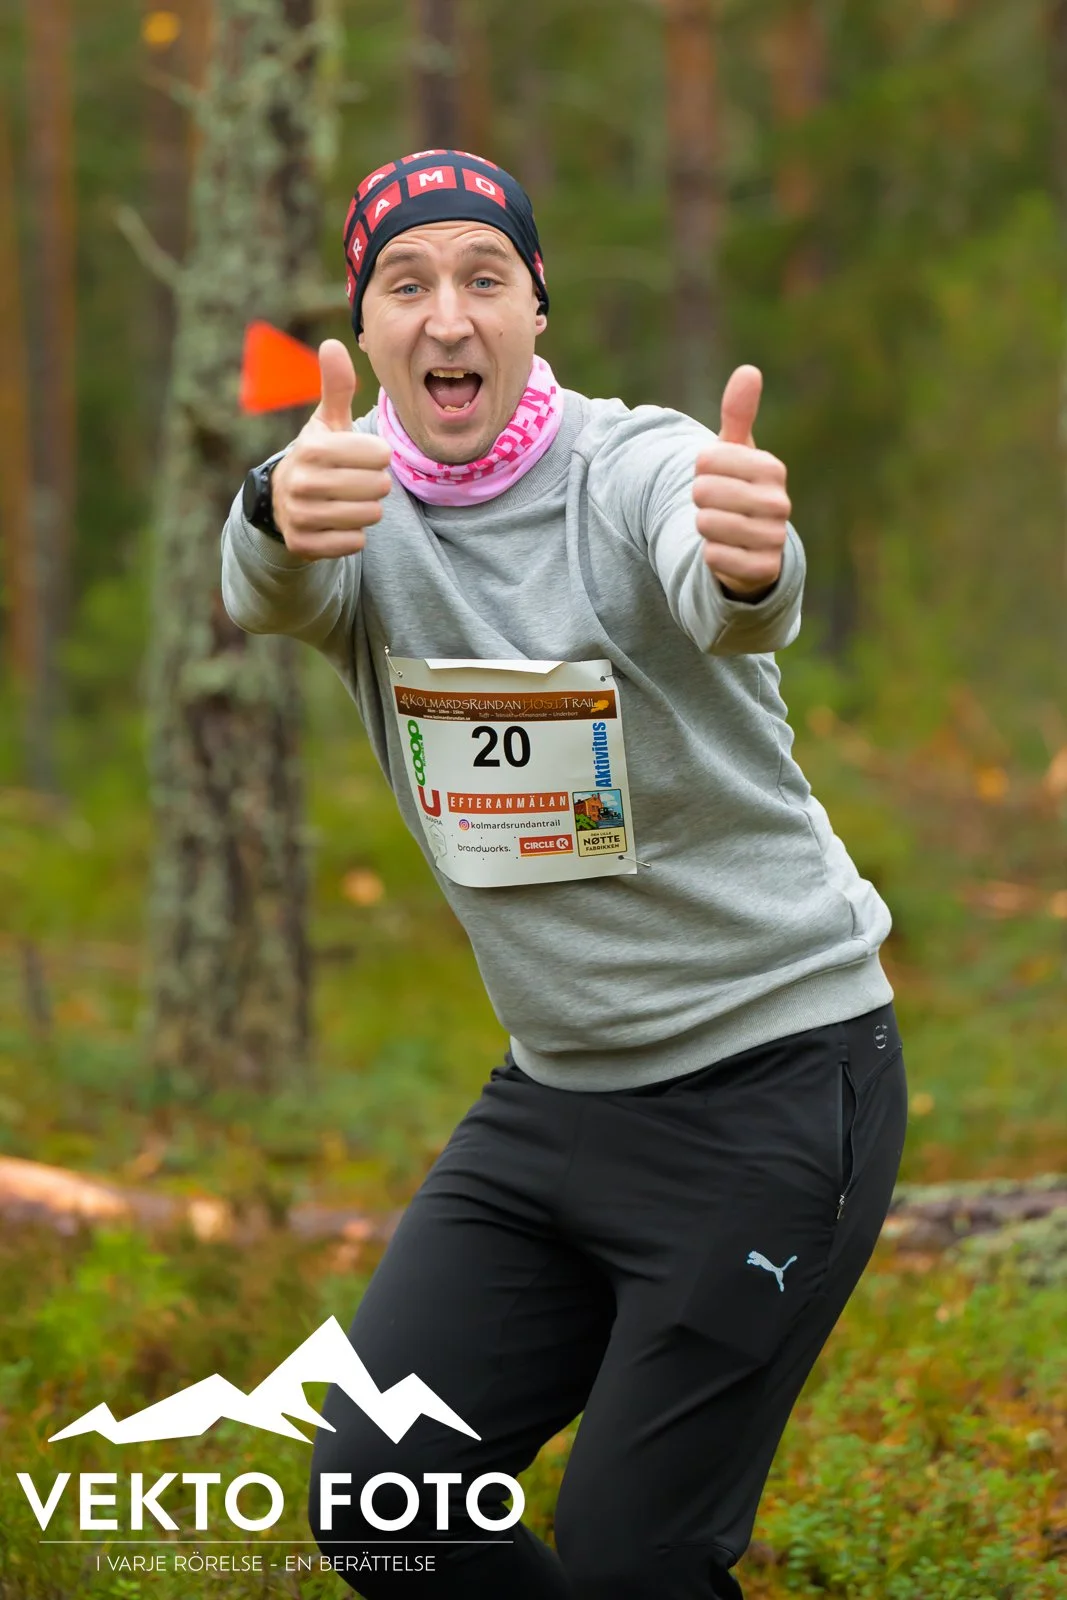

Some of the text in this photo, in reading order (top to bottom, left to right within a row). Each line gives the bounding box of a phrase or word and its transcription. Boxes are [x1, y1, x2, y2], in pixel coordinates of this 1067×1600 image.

[471, 725, 531, 768] 20
[592, 721, 612, 787] Aktivitus
[450, 795, 566, 809] EFTERANMÄLAN
[471, 819, 561, 830] kolmardsrundantrail
[524, 838, 568, 850] CIRCLE K
[583, 835, 621, 846] NØTTE
[585, 843, 620, 851] FABRIKKEN
